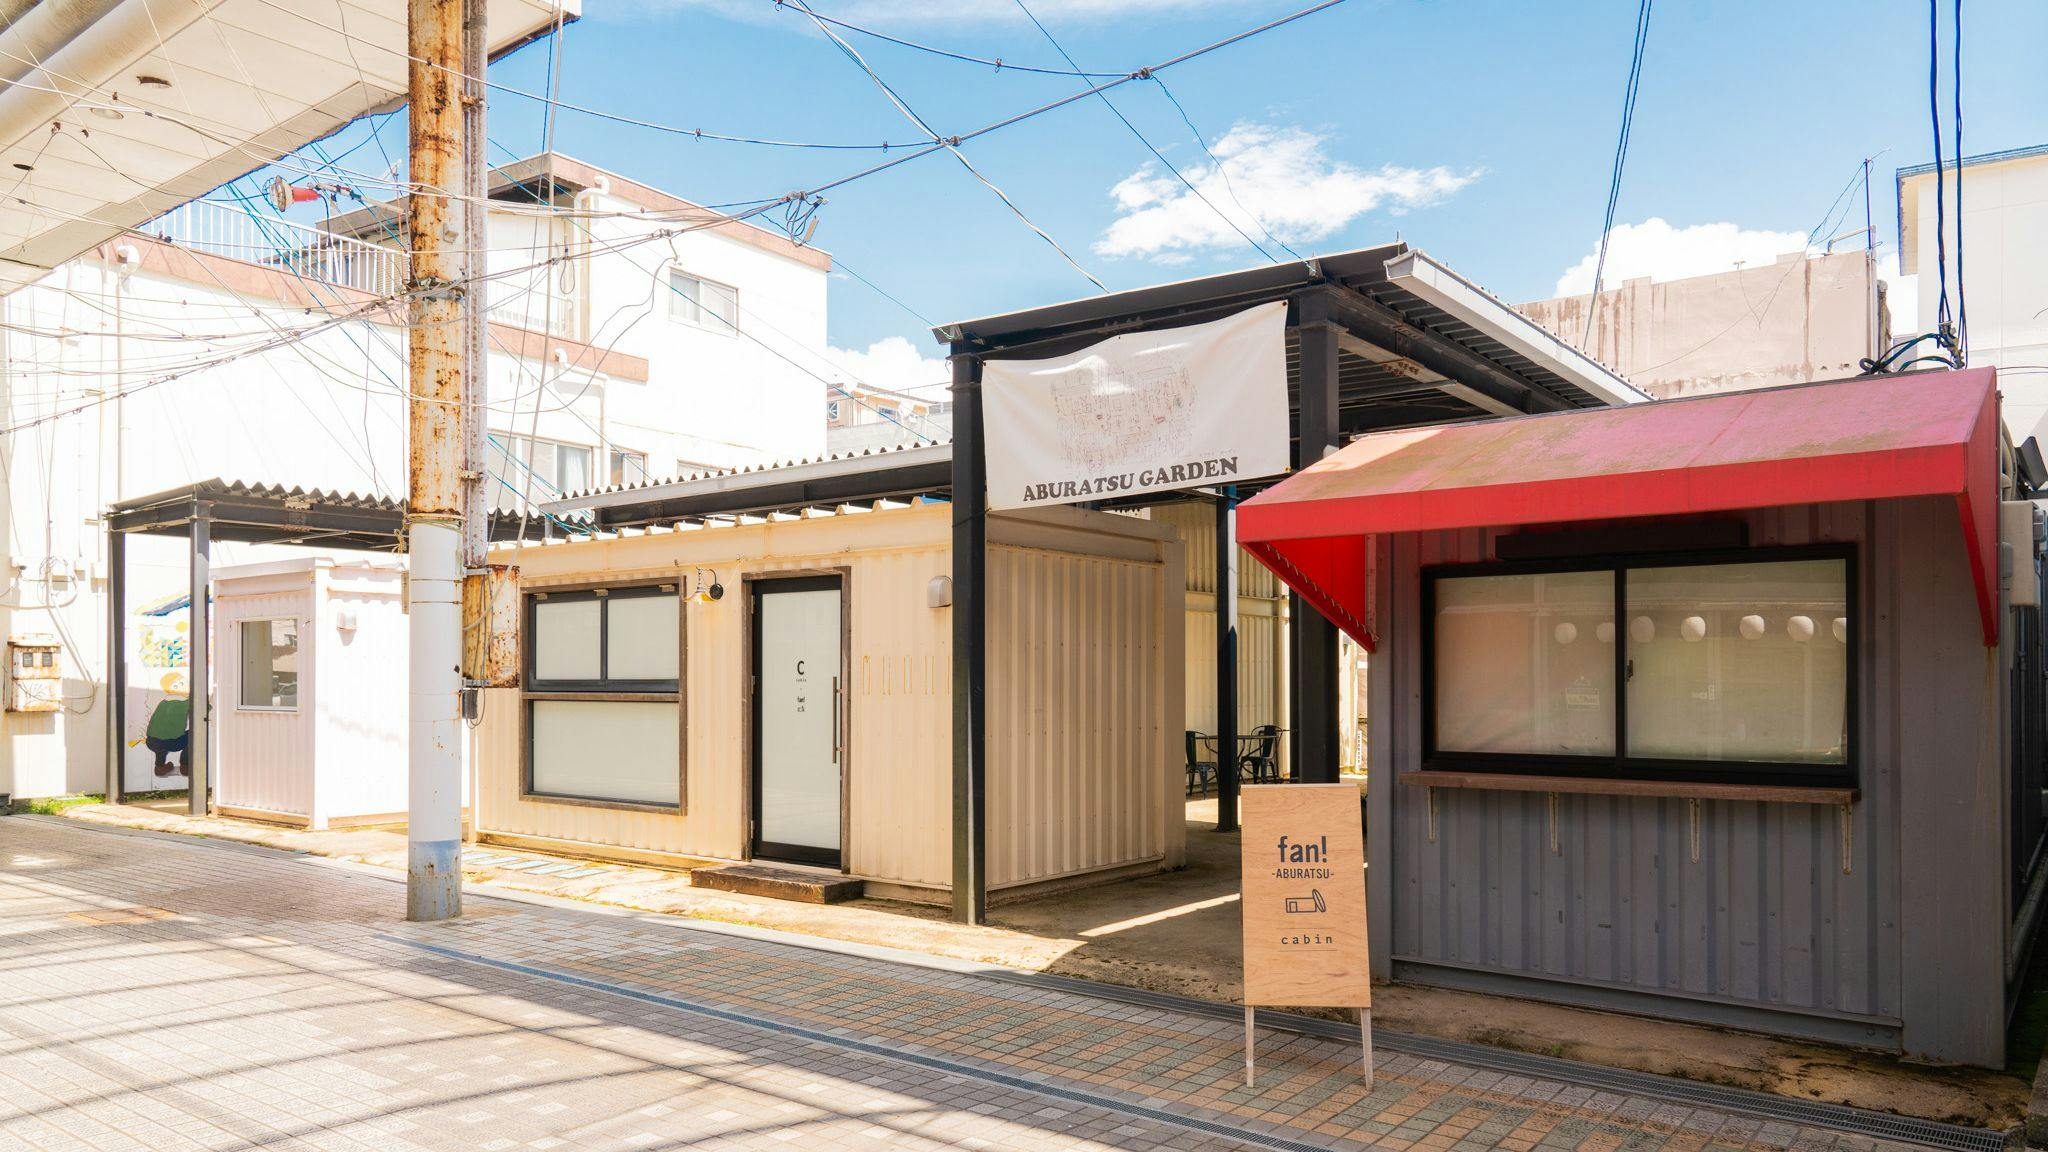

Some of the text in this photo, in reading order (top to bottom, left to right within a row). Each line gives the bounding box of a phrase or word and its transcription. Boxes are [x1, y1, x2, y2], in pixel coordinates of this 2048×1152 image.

[1023, 456, 1239, 502] ABURATSU GARDEN
[1277, 835, 1328, 863] fan!
[1271, 868, 1335, 879] -ABURATSU-
[1281, 934, 1333, 945] cabin
